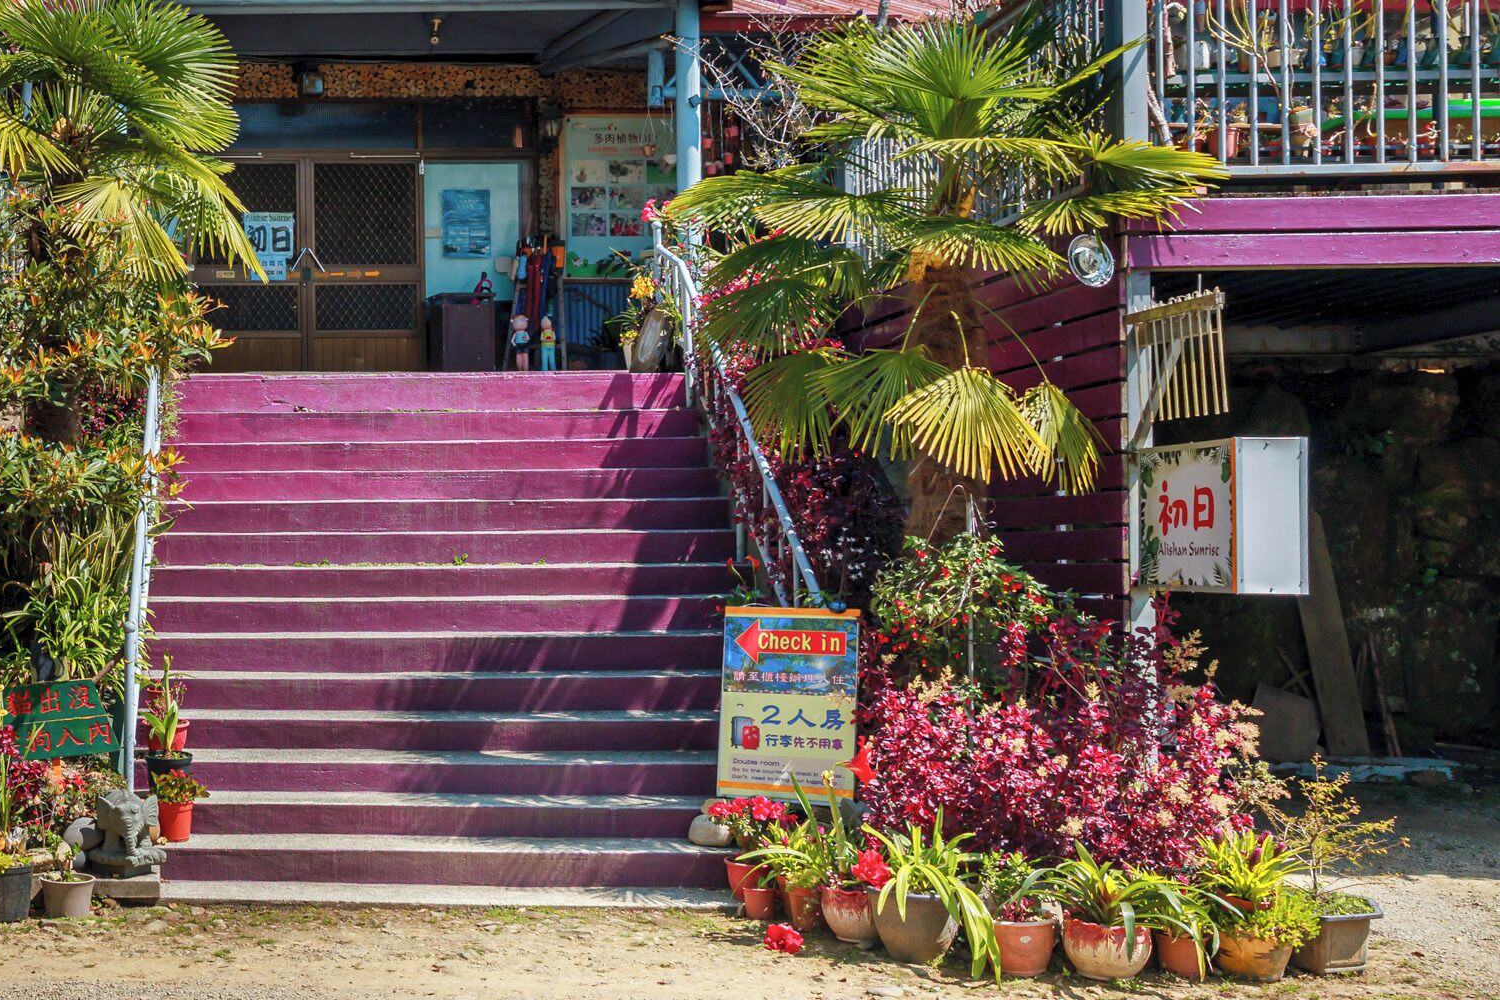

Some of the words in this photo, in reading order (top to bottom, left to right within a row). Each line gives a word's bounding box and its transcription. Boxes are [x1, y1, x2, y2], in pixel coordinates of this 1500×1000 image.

[247, 225, 291, 252] 初日
[1158, 480, 1215, 536] 初日
[1158, 541, 1187, 556] Alishan
[1189, 541, 1220, 557] Sunrise
[758, 632, 811, 651] Check
[821, 633, 840, 652] in
[7, 685, 97, 717] 貓出沒
[761, 705, 846, 731] 2人房
[12, 722, 111, 752] 狗入內
[765, 734, 843, 750] 行李先不用拿
[732, 758, 758, 766] Double
